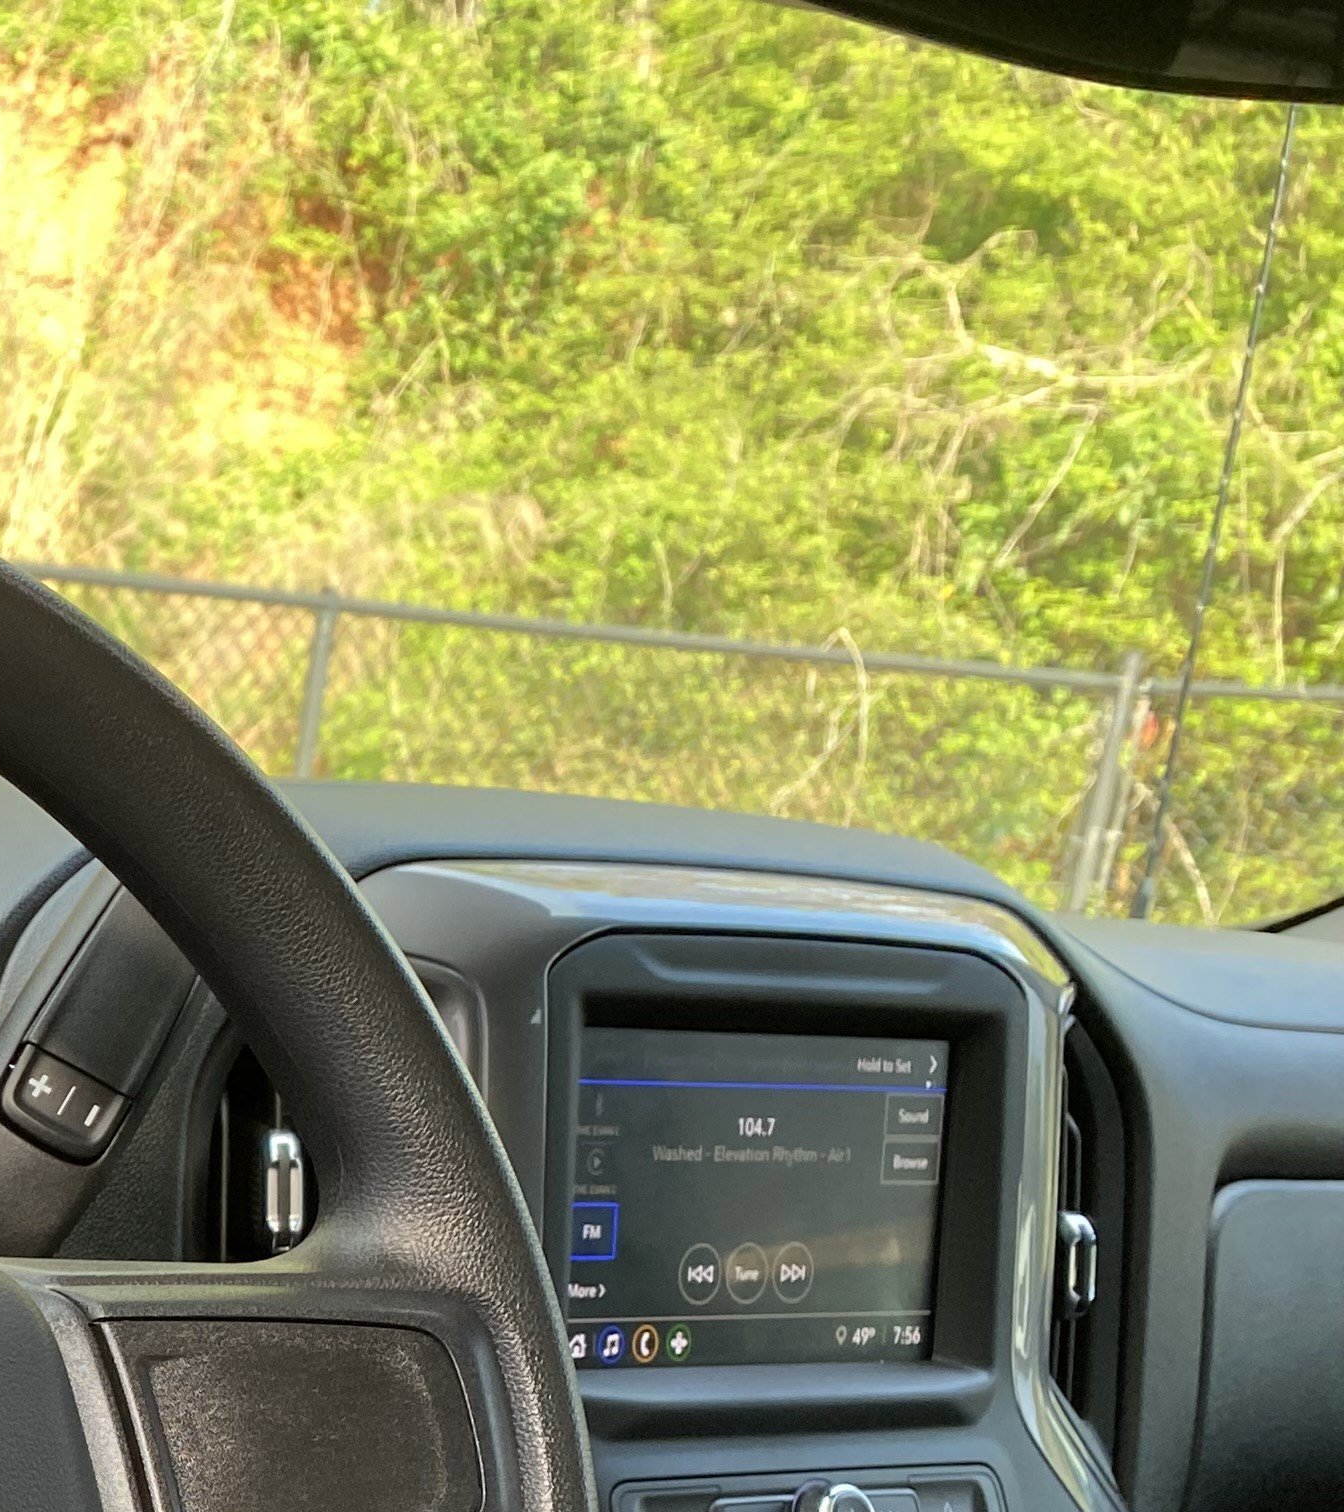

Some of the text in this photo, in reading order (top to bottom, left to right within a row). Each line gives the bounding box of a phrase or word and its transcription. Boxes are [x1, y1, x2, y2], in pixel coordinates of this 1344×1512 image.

[738, 1117, 776, 1137] 104.7
[653, 1145, 703, 1162] Washed
[714, 1145, 769, 1162] Elevation
[893, 1154, 929, 1170] Browse
[582, 1224, 601, 1239] FM
[735, 1267, 759, 1282] Tune
[567, 1284, 596, 1298] More
[893, 1326, 922, 1346] 7:56
